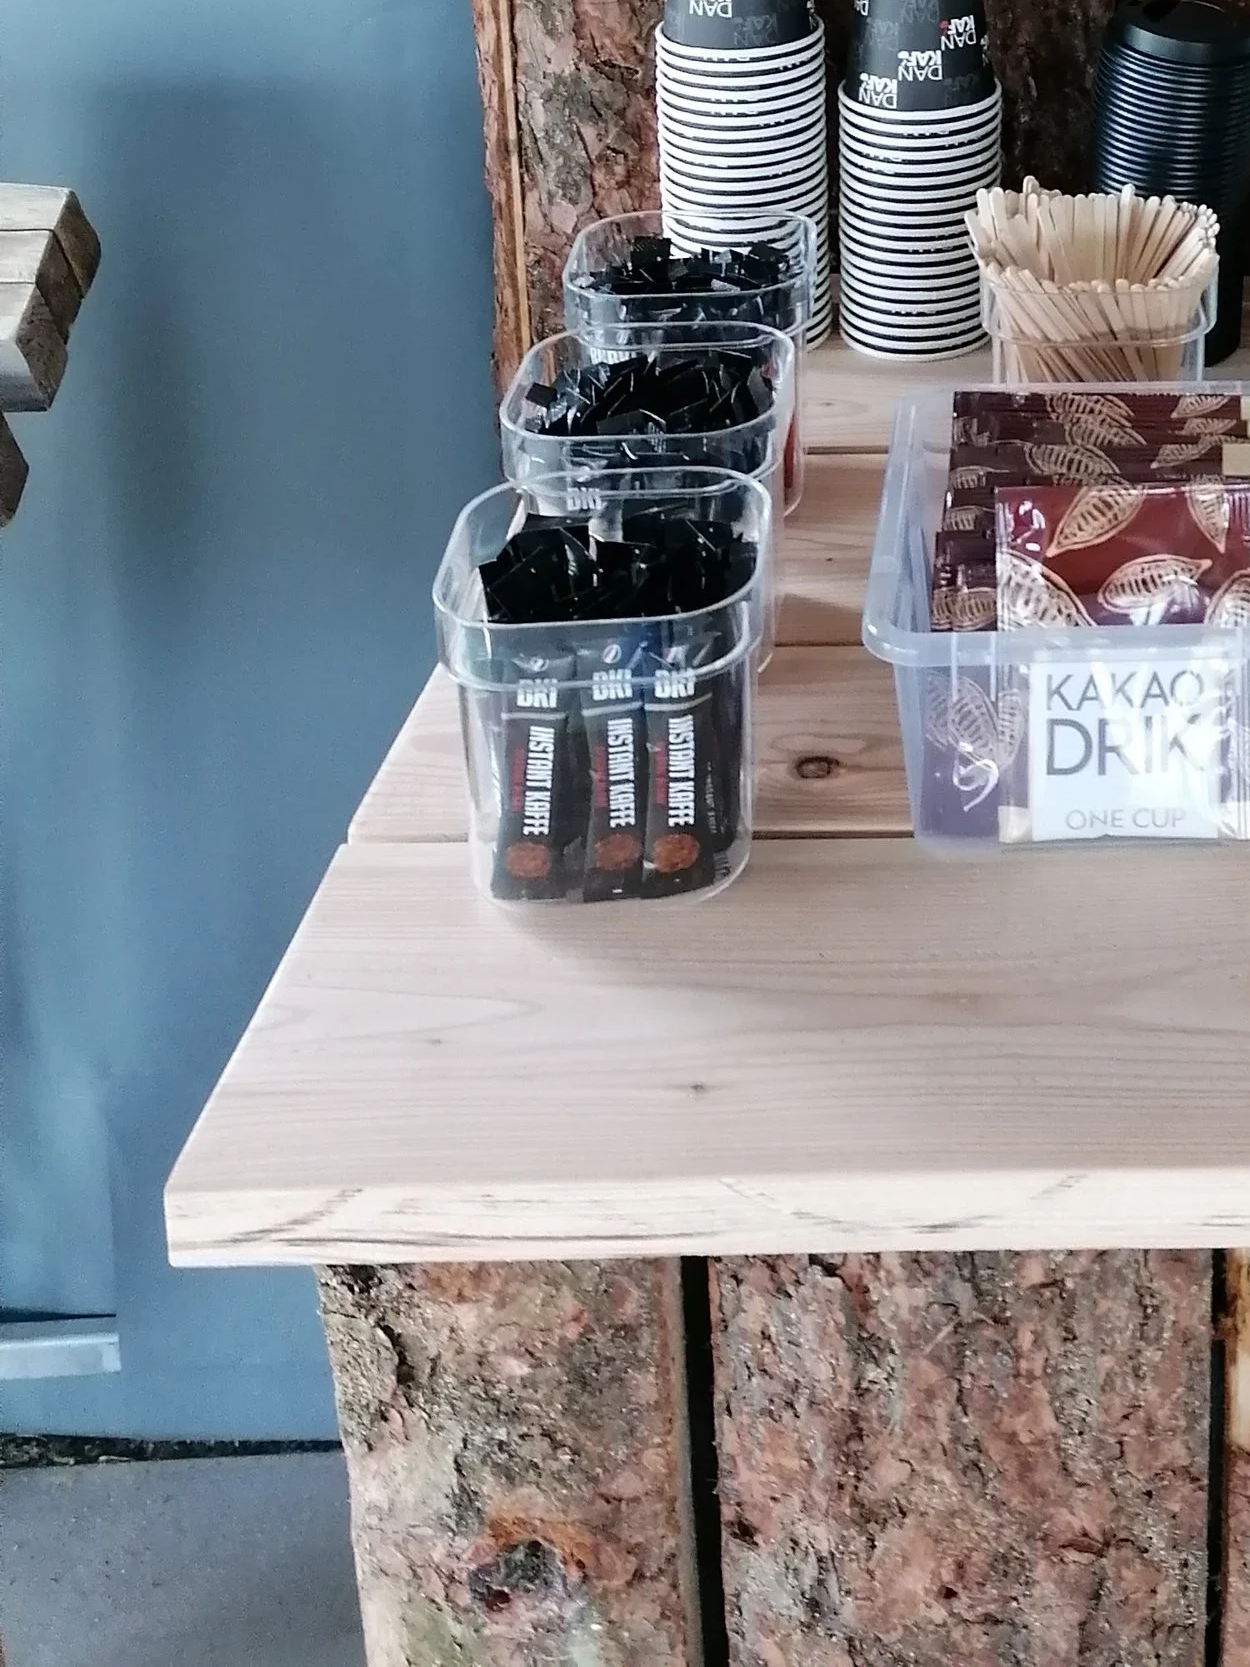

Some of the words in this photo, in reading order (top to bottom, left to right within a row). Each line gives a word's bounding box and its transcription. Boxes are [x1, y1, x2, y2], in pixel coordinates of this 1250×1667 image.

[689, 0, 732, 18] DAN
[941, 30, 977, 51] DAN
[898, 65, 943, 81] DAN
[859, 87, 897, 110] DAN
[1046, 671, 1204, 712] KAKAO
[526, 725, 555, 790] INSTANT
[607, 718, 635, 782] INSTANT
[668, 714, 695, 779] INSTANT
[1045, 717, 1204, 777] DRIK
[522, 790, 551, 836] KAFFE
[609, 782, 636, 828] KAFFE
[668, 780, 695, 828] KAFFE
[1065, 809, 1125, 832] ONE
[1132, 807, 1187, 830] CUP
